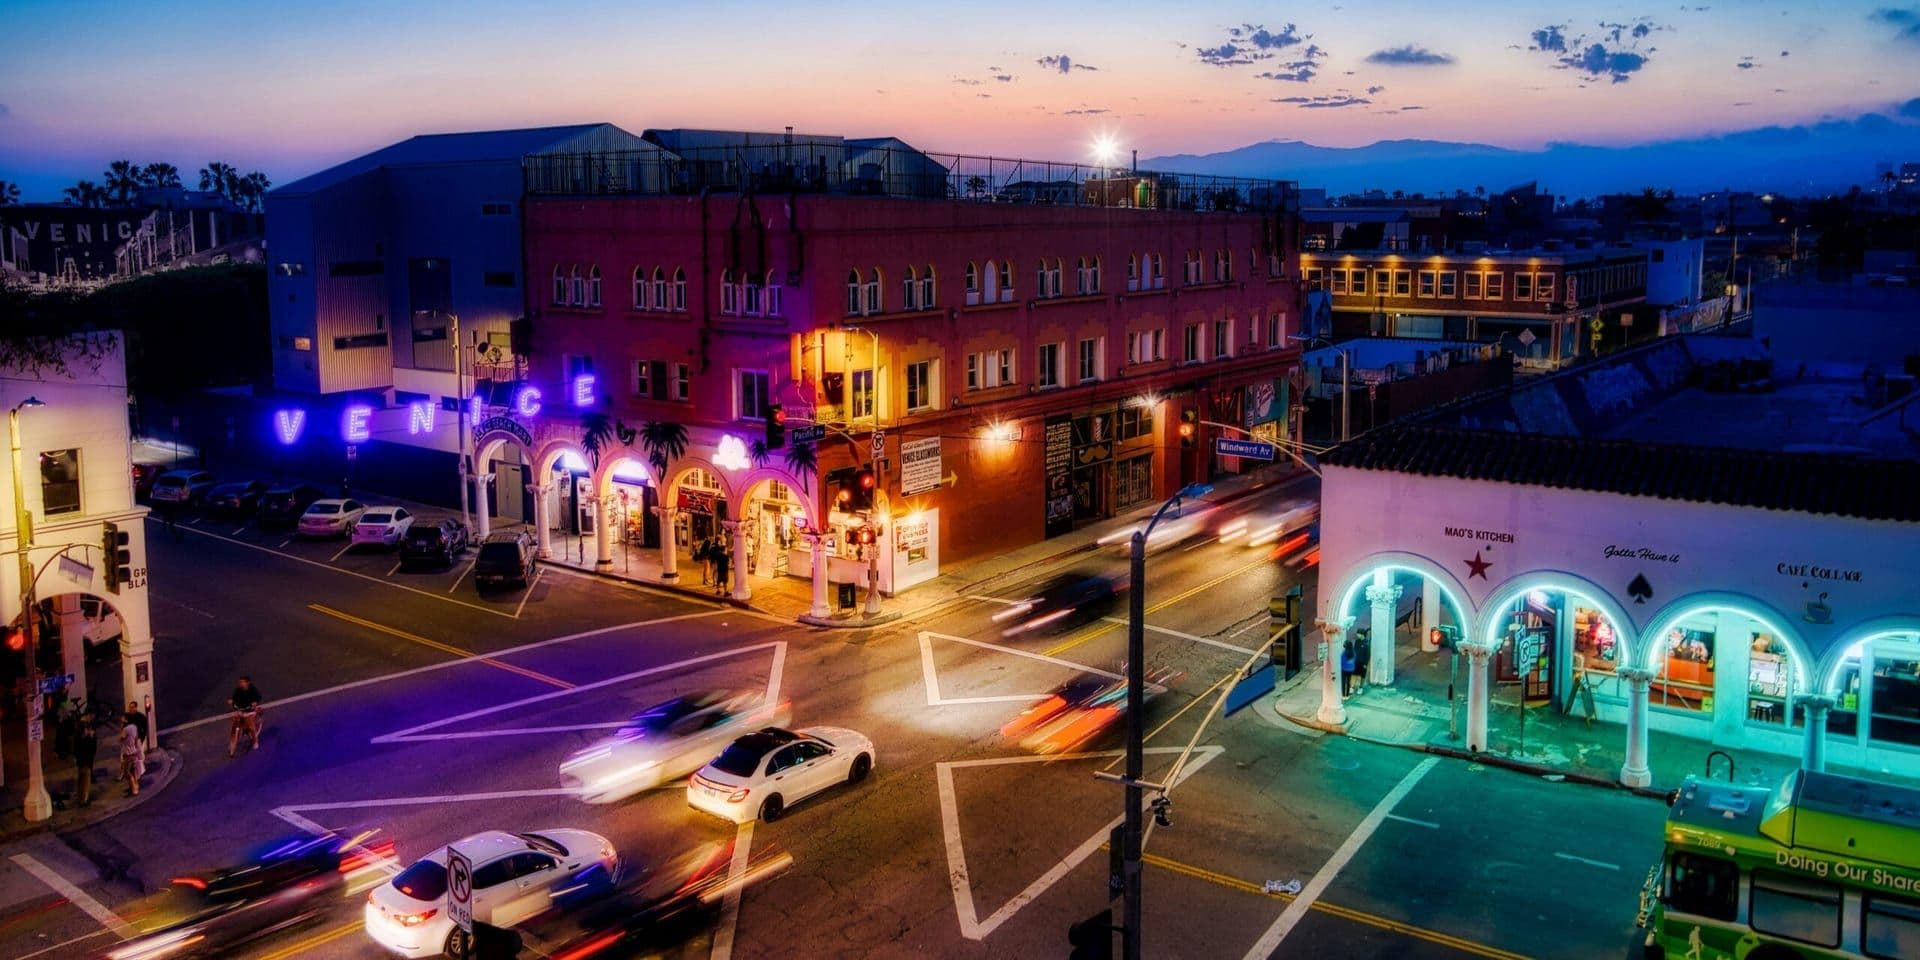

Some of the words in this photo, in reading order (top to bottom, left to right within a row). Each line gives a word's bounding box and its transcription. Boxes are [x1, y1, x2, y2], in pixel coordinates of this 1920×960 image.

[277, 374, 597, 444] VENICE
[794, 430, 814, 441] Pacific
[1220, 441, 1258, 455] Windward
[1259, 446, 1271, 456] Av
[1445, 526, 1473, 539] MAO'S
[1475, 530, 1514, 543] KITCHEN
[1604, 544, 1636, 559] Gotta
[1638, 548, 1668, 561] Have
[1669, 553, 1680, 563] it
[1810, 566, 1863, 582] COLLAGE
[1776, 850, 1829, 877] Doing
[1834, 862, 1868, 882] Our
[1872, 869, 1920, 892] Share
[450, 901, 458, 917] ON
